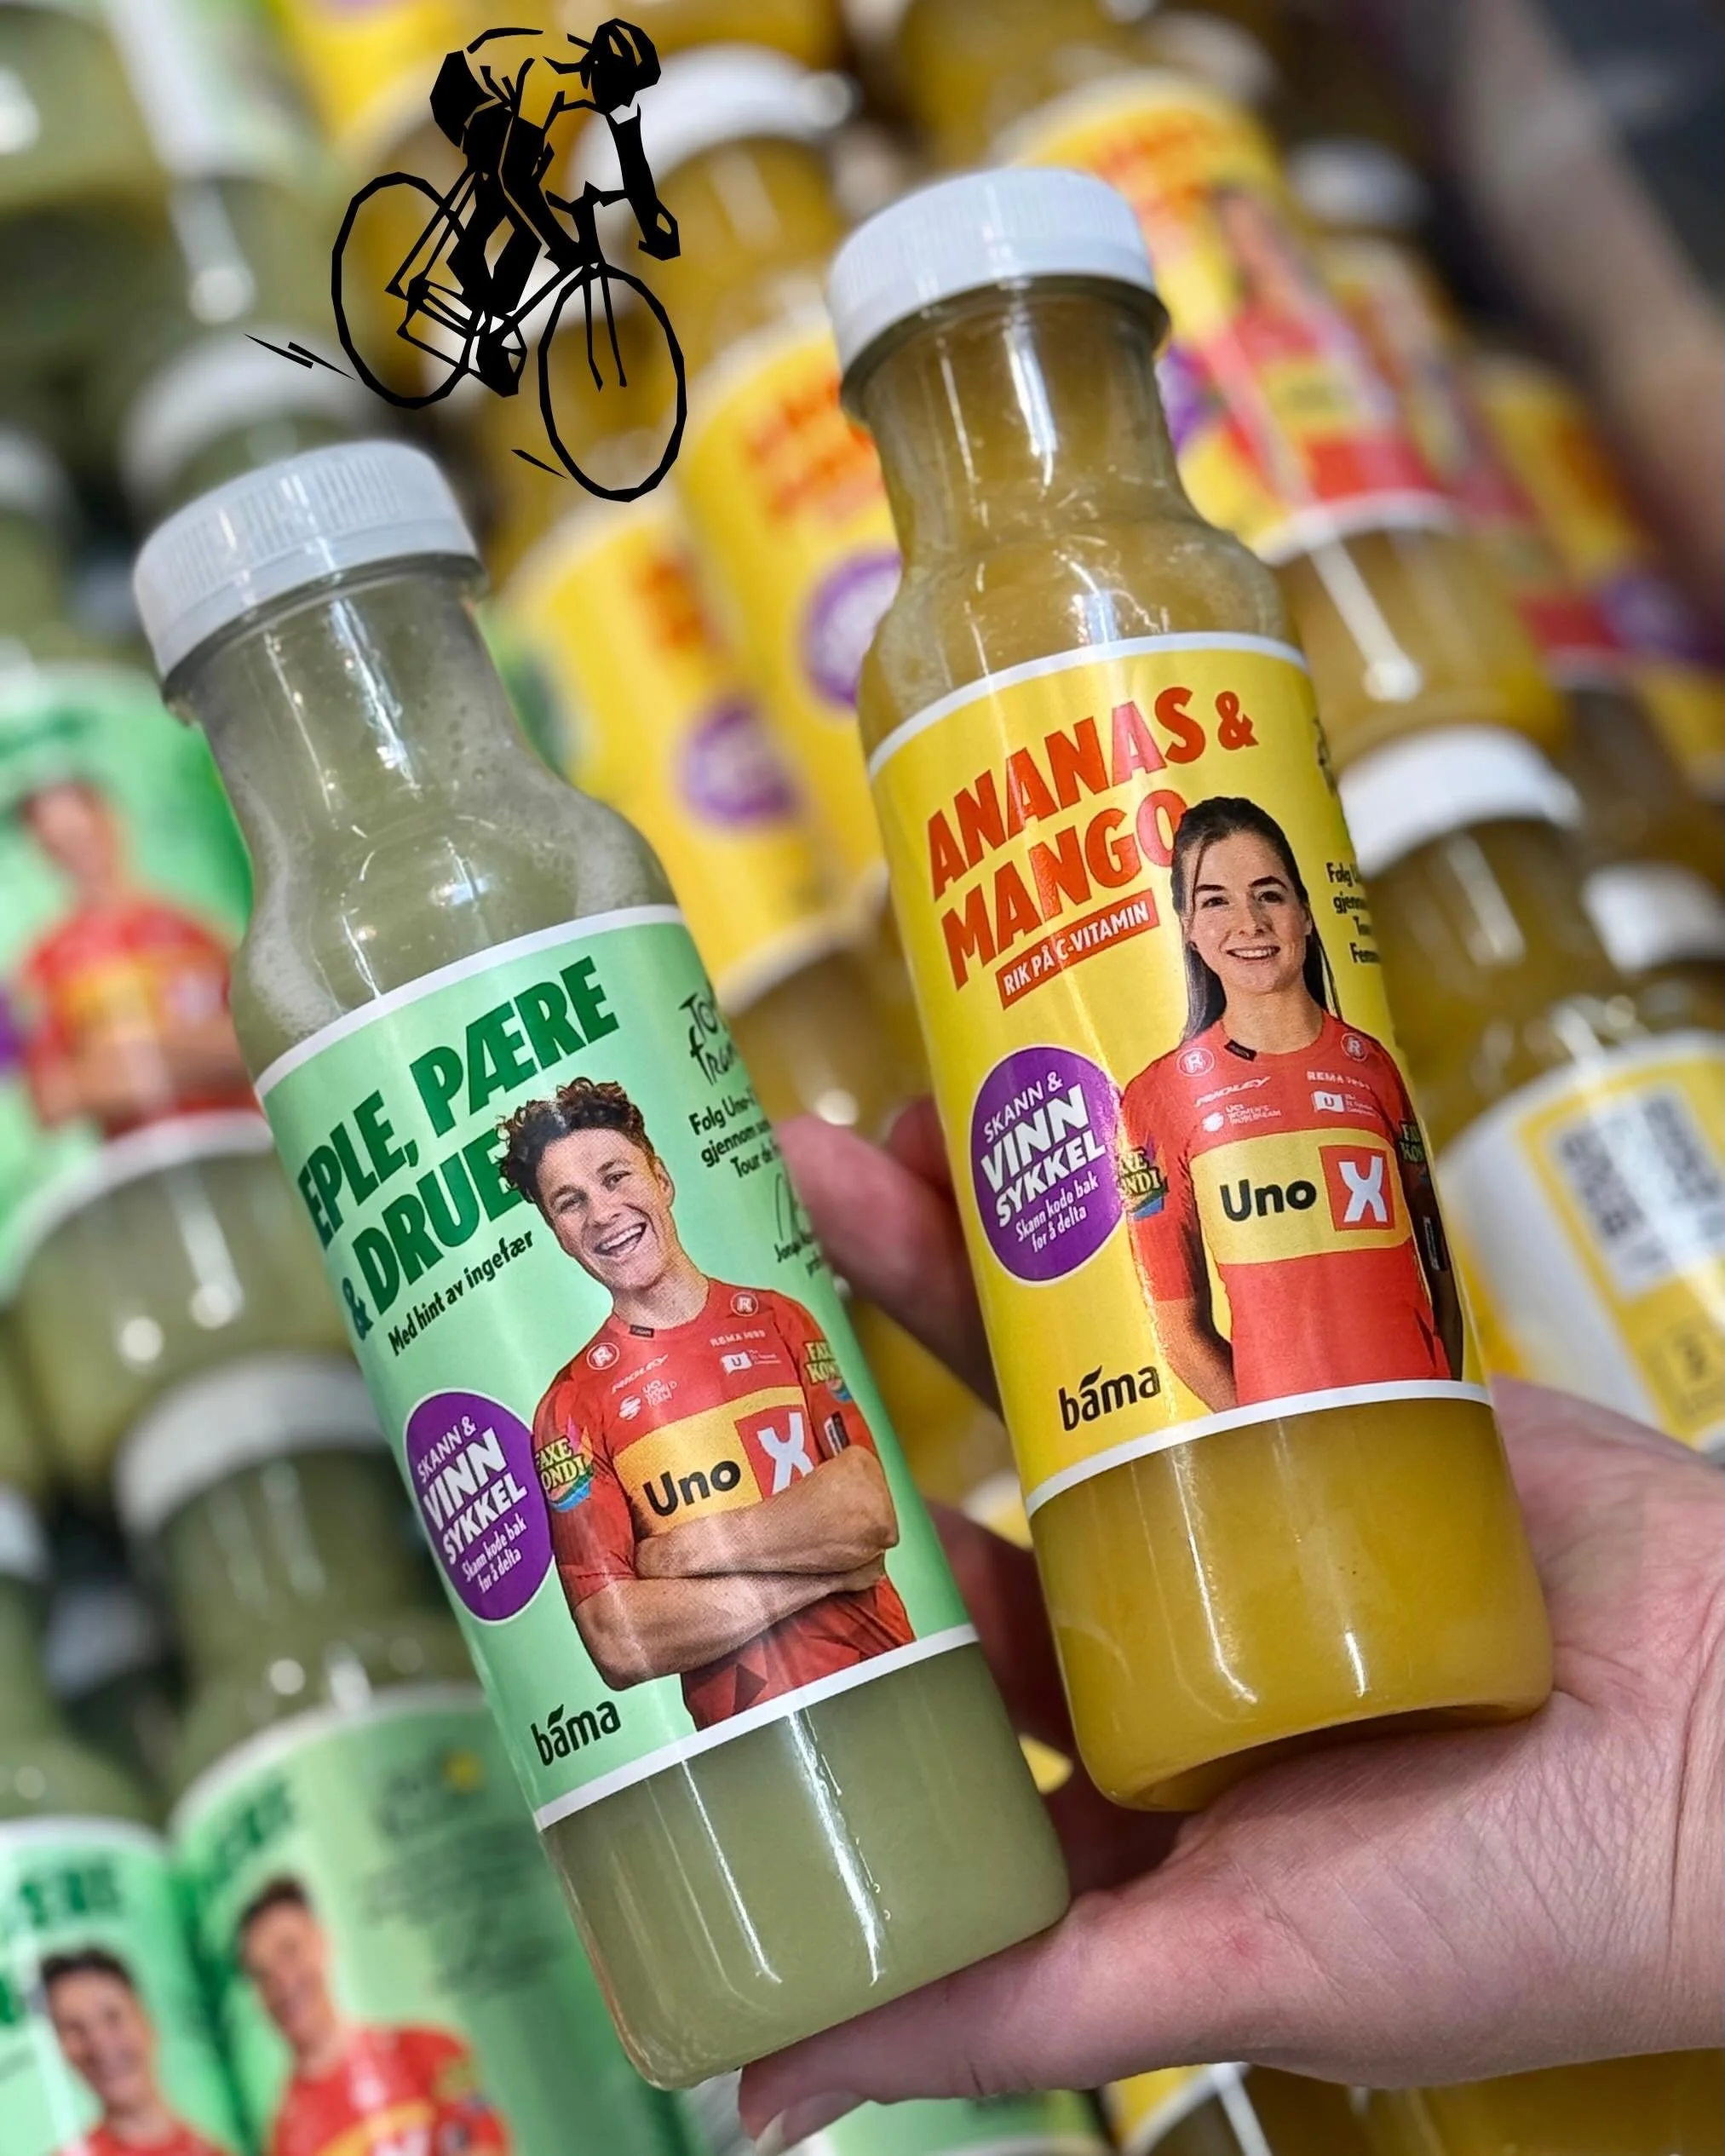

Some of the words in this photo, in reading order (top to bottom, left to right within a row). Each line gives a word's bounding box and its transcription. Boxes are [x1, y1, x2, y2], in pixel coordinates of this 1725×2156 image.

[927, 687, 1206, 902] ANANAS
[1215, 691, 1259, 750] &
[940, 789, 1188, 992] MANGO
[1003, 963, 1032, 996] RIK
[1031, 945, 1055, 977] PÅ
[1055, 900, 1149, 961] C-VITAMIN
[298, 1089, 420, 1252] EPLE,
[409, 955, 620, 1138] PÆRE
[980, 1084, 1090, 1193] VINN
[983, 1080, 1044, 1144] SKANN
[1047, 1071, 1063, 1092] &
[730, 1155, 761, 1178] Tour
[995, 1129, 1107, 1227] SYKKEL
[1015, 1210, 1047, 1242] Skann
[1045, 1187, 1074, 1219] kode
[1073, 1170, 1100, 1199] bak
[1220, 1179, 1317, 1222] Uno
[1338, 1155, 1388, 1223] X
[352, 1127, 525, 1315] DRUE
[1032, 1233, 1047, 1253] for
[1057, 1206, 1088, 1234] delta
[342, 1277, 374, 1341] &
[388, 1312, 418, 1356] Med
[412, 1291, 446, 1331] hint
[446, 1279, 464, 1305] av
[463, 1230, 534, 1290] ingefær
[417, 1425, 463, 1483] SKANN
[461, 1416, 477, 1437] &
[423, 1427, 508, 1532] VINN
[642, 1461, 740, 1517] Uno
[756, 1411, 814, 1496] X
[442, 1473, 527, 1566] SYKKEL
[482, 1531, 509, 1561] kode
[503, 1513, 527, 1542] bak
[497, 1549, 522, 1576] delta
